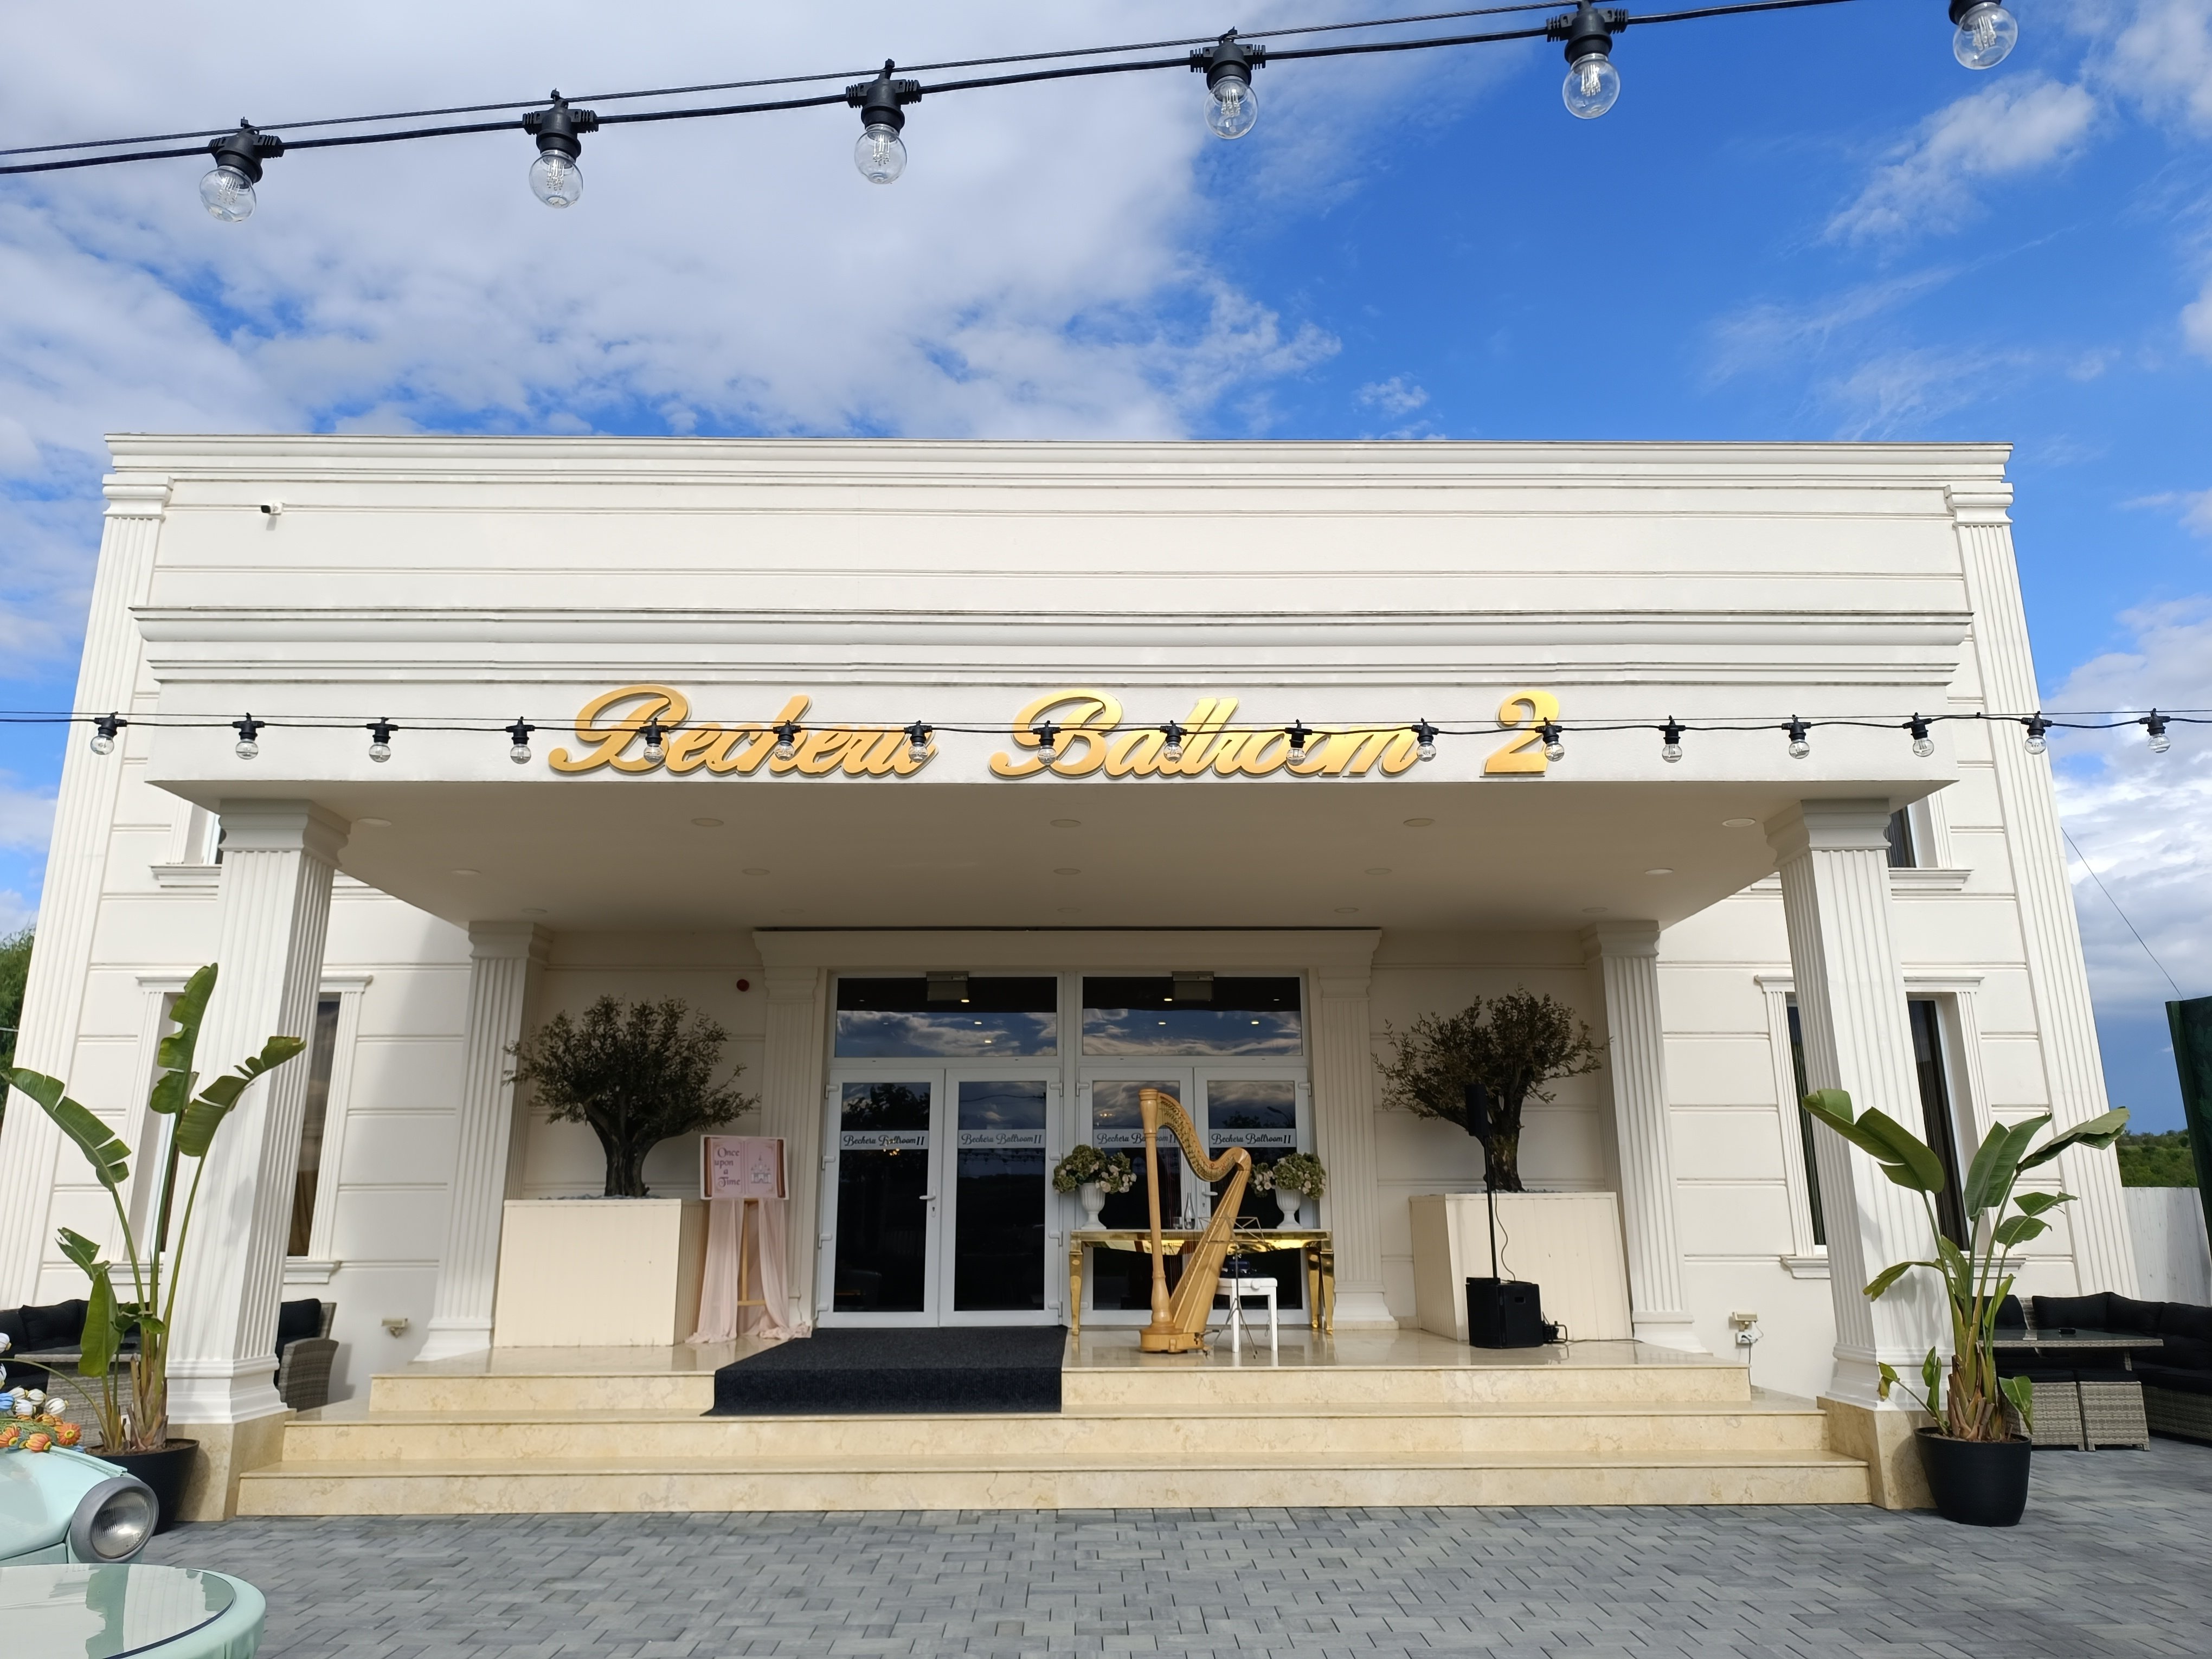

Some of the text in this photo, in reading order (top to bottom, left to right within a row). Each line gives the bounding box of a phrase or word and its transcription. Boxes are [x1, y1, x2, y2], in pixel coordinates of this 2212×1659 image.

[548, 684, 1561, 777] Becheru Ballroom 2
[843, 1135, 876, 1146] Becheru
[961, 1133, 994, 1145] Becheru
[996, 1133, 1033, 1144] Ballroom
[1097, 1133, 1129, 1144] Becheru
[1211, 1133, 1244, 1145] Becheru
[1245, 1133, 1283, 1144] Ballroom
[717, 1147, 740, 1158] Once
[714, 1160, 734, 1169] upon
[718, 1176, 741, 1187] Time
